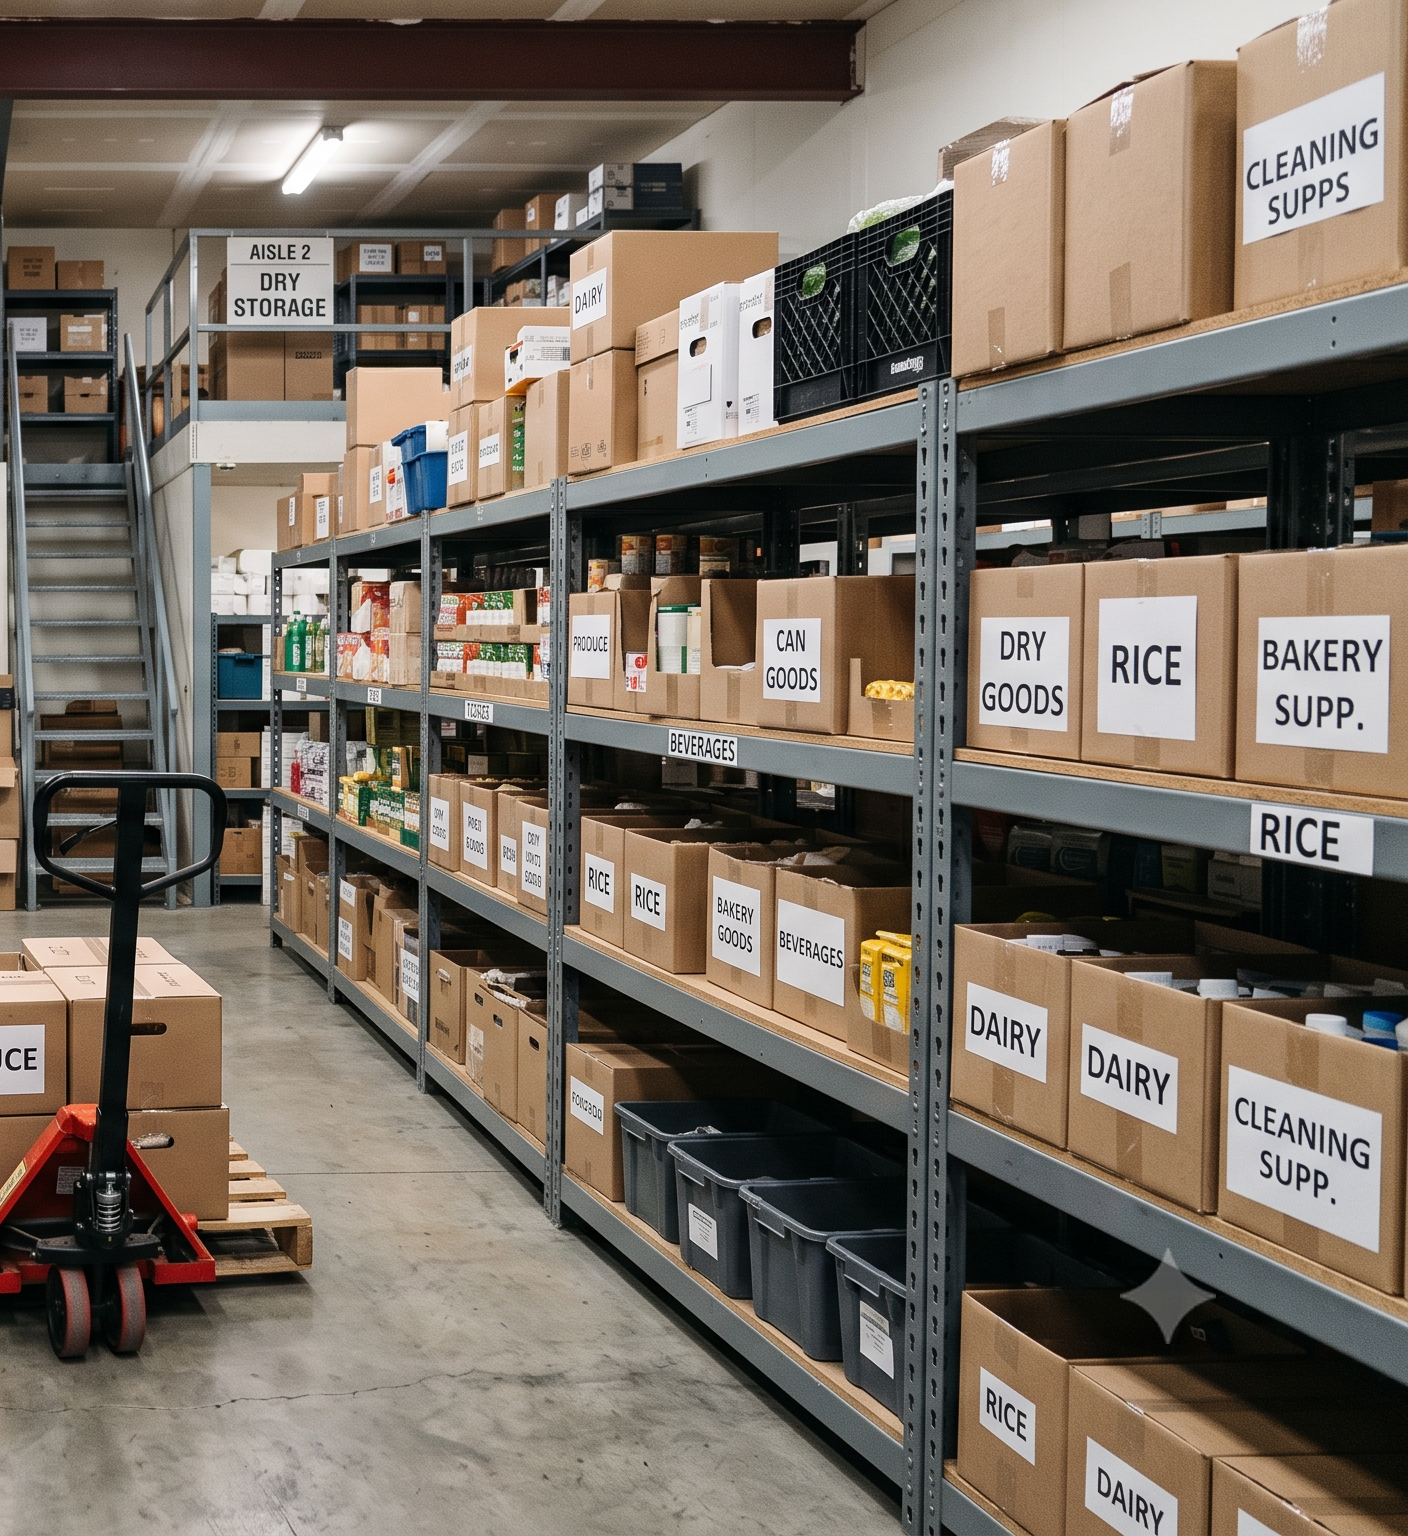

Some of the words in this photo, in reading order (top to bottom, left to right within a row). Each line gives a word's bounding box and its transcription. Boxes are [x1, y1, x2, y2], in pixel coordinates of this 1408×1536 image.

[1246, 117, 1379, 191] CLEANING
[1268, 171, 1349, 225] SUPPS
[250, 244, 296, 260] AISLE
[302, 244, 310, 260] 2
[261, 273, 300, 291] DRY
[575, 283, 603, 314] DAIRY
[234, 298, 326, 317] STORAGE
[777, 630, 805, 652] CAN
[1001, 631, 1046, 661] DRY
[1263, 639, 1383, 672] BAKERY
[766, 666, 817, 691] GOODS
[1112, 645, 1181, 686] RICE
[982, 682, 1063, 716] GOODS
[1275, 694, 1363, 730] SUPP.
[671, 733, 735, 762] BEVERAGES
[1261, 813, 1340, 862] RICE
[589, 867, 610, 896] RICE
[635, 884, 660, 916] RICE
[717, 897, 754, 925] BAKERY
[718, 925, 752, 953] GOODS
[780, 930, 843, 969] BEVERAGES
[971, 1005, 1041, 1058] DAIRY
[1088, 1044, 1170, 1105] DAIRY
[1235, 1097, 1370, 1170] CLEANING
[1260, 1150, 1336, 1205] SUPP.
[986, 1387, 1027, 1442] RICE
[1098, 1467, 1164, 1536] DAIRY
